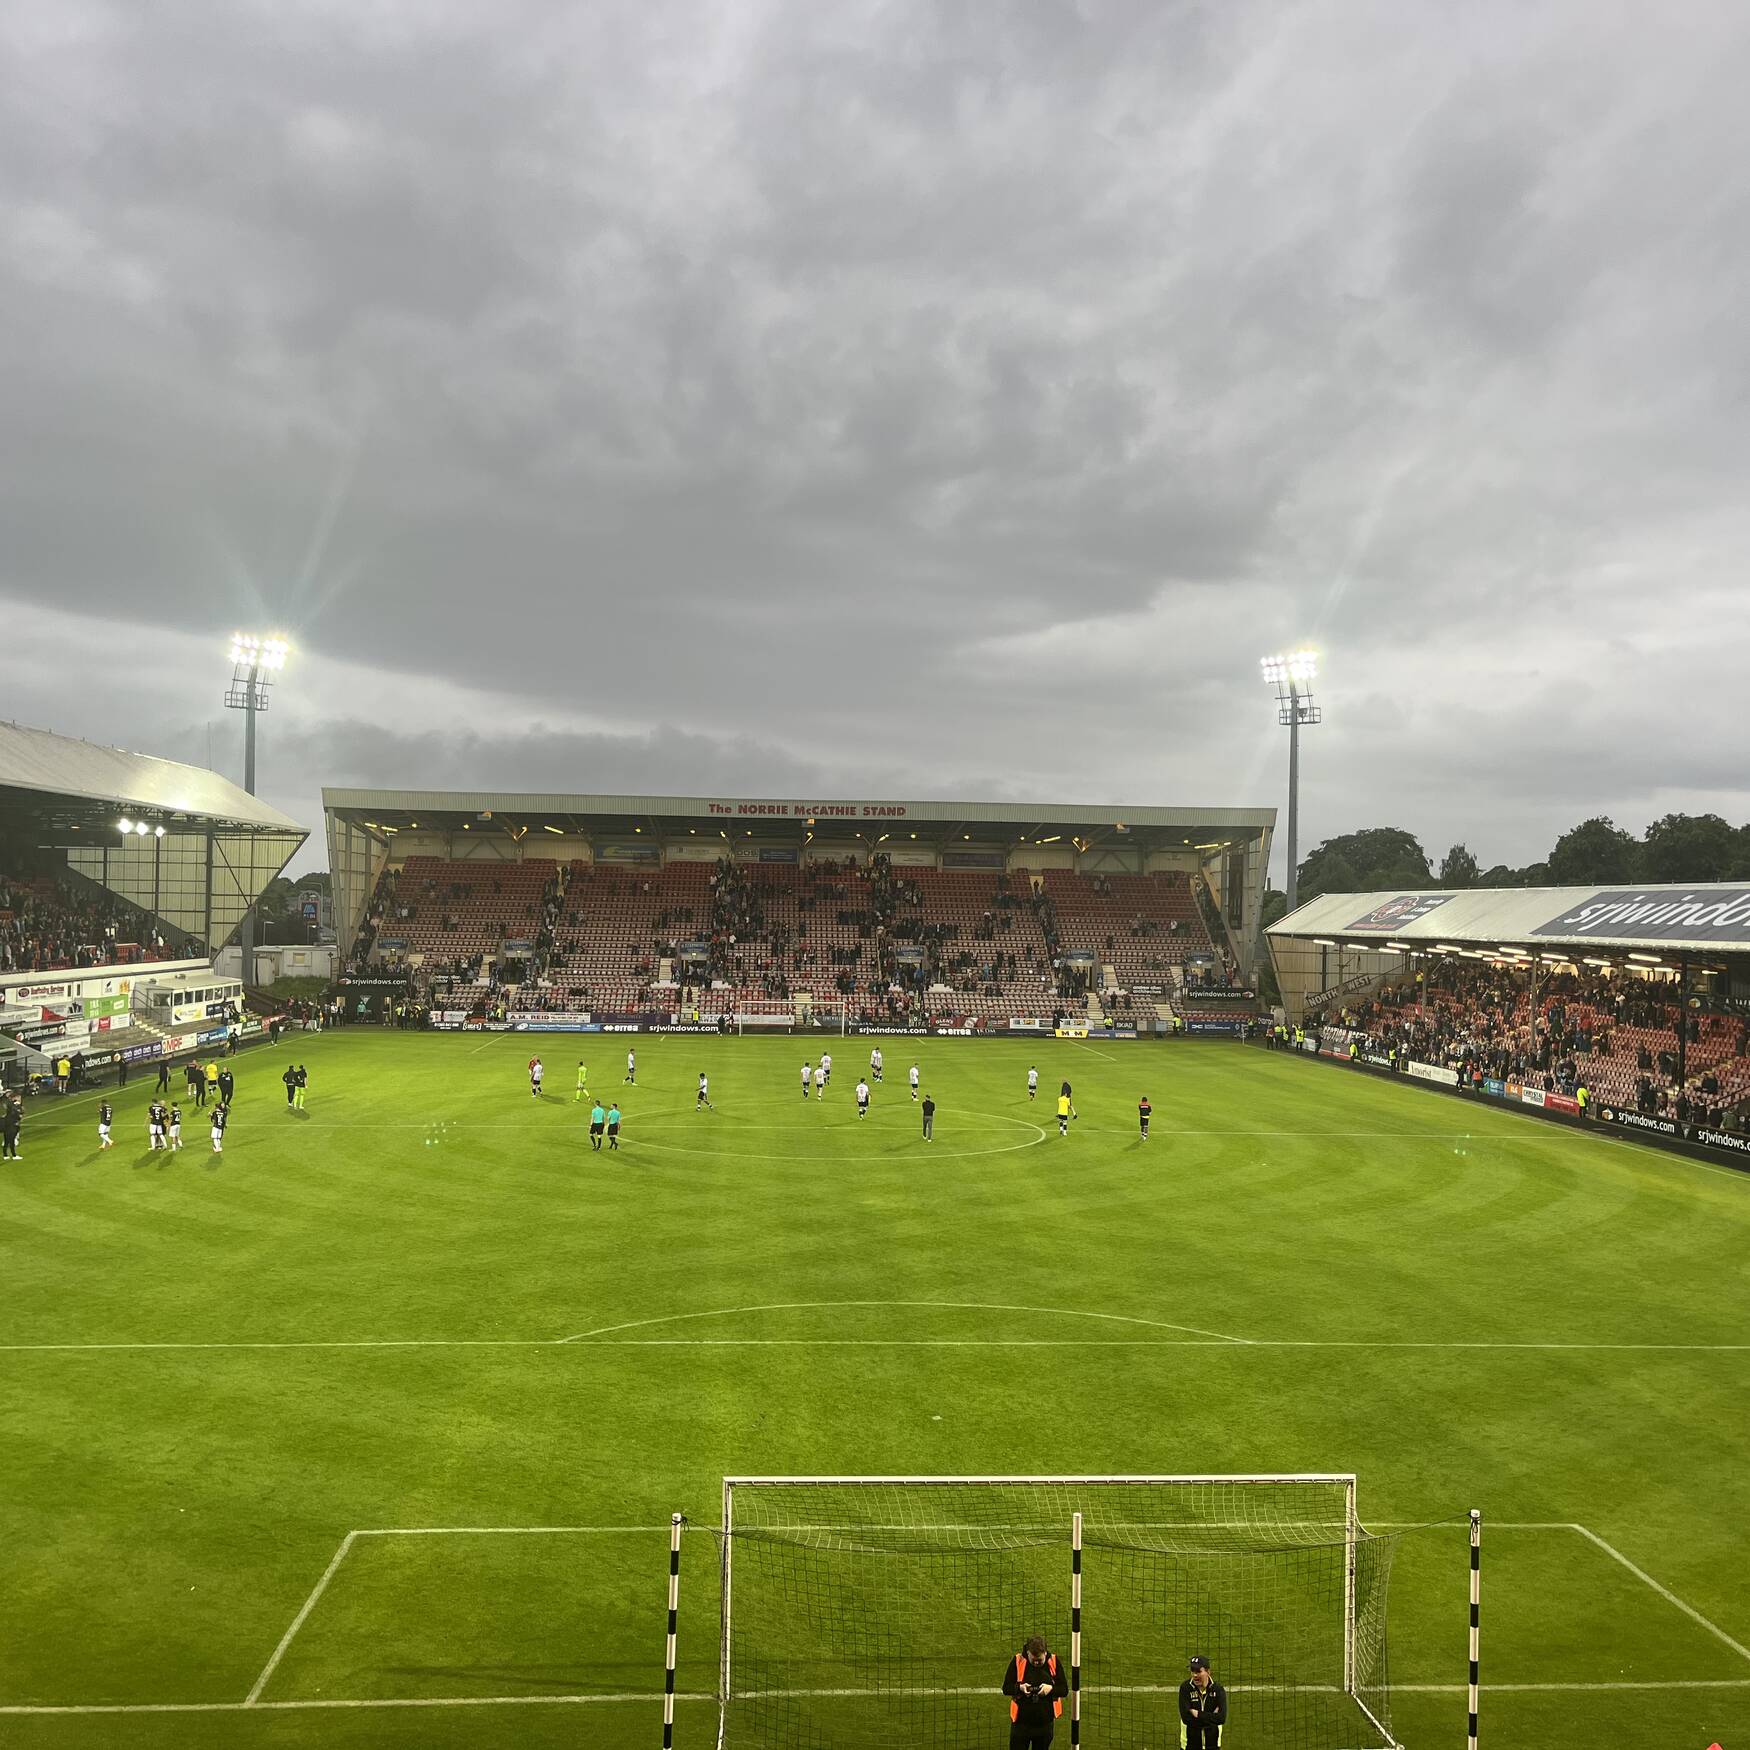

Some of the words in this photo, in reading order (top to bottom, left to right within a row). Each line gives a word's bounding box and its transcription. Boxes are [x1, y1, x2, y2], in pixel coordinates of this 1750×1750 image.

[709, 804, 732, 814] The
[738, 804, 788, 815] NORRIE
[794, 805, 857, 816] McCATHIE
[863, 806, 906, 817] STAND
[1564, 894, 1750, 931] srjwindo
[1347, 976, 1371, 991] WEST
[1189, 990, 1241, 998] srjwindows.com
[1308, 988, 1338, 1007] NORTH
[649, 1024, 719, 1033] srjwindows.com
[858, 1026, 927, 1035] srjwindows.com
[948, 1028, 971, 1036] errea
[167, 1035, 182, 1050] MPF
[1618, 1111, 1675, 1133] srjwindows.com
